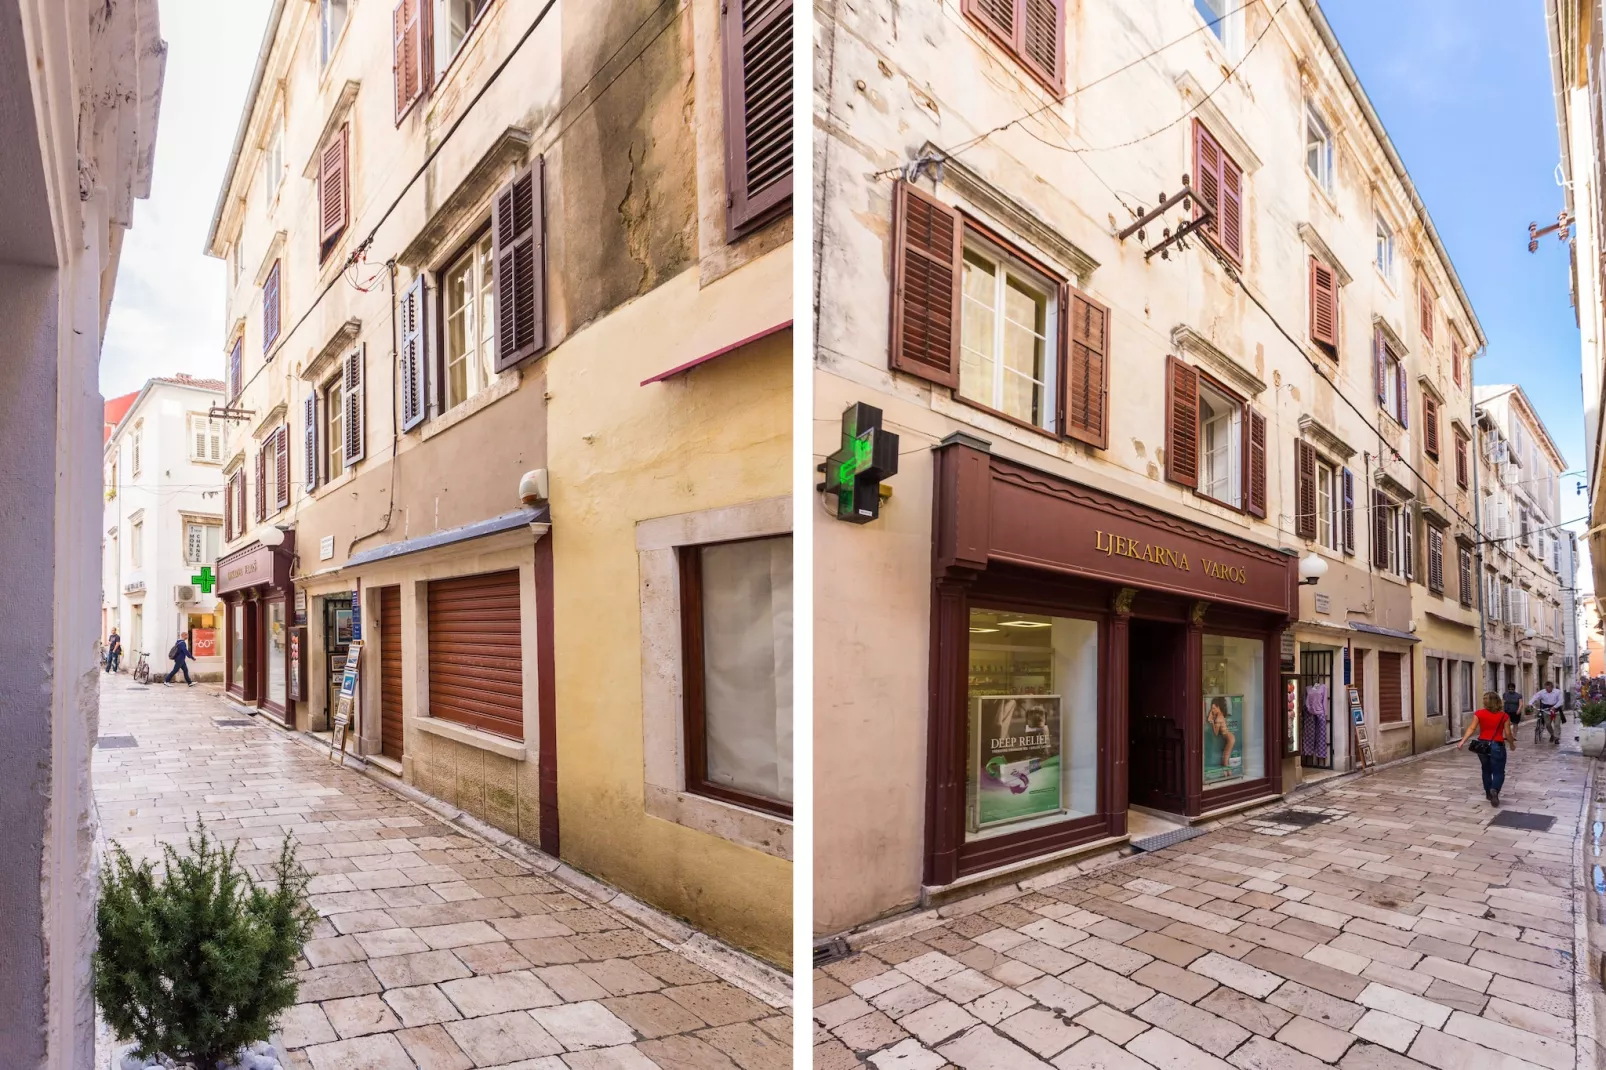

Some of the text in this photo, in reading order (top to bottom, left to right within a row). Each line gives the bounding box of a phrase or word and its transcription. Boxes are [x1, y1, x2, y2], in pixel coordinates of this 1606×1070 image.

[1095, 530, 1191, 571] LJEKARNA
[991, 737, 1017, 749] DEEP
[1019, 734, 1049, 747] RELIEF
